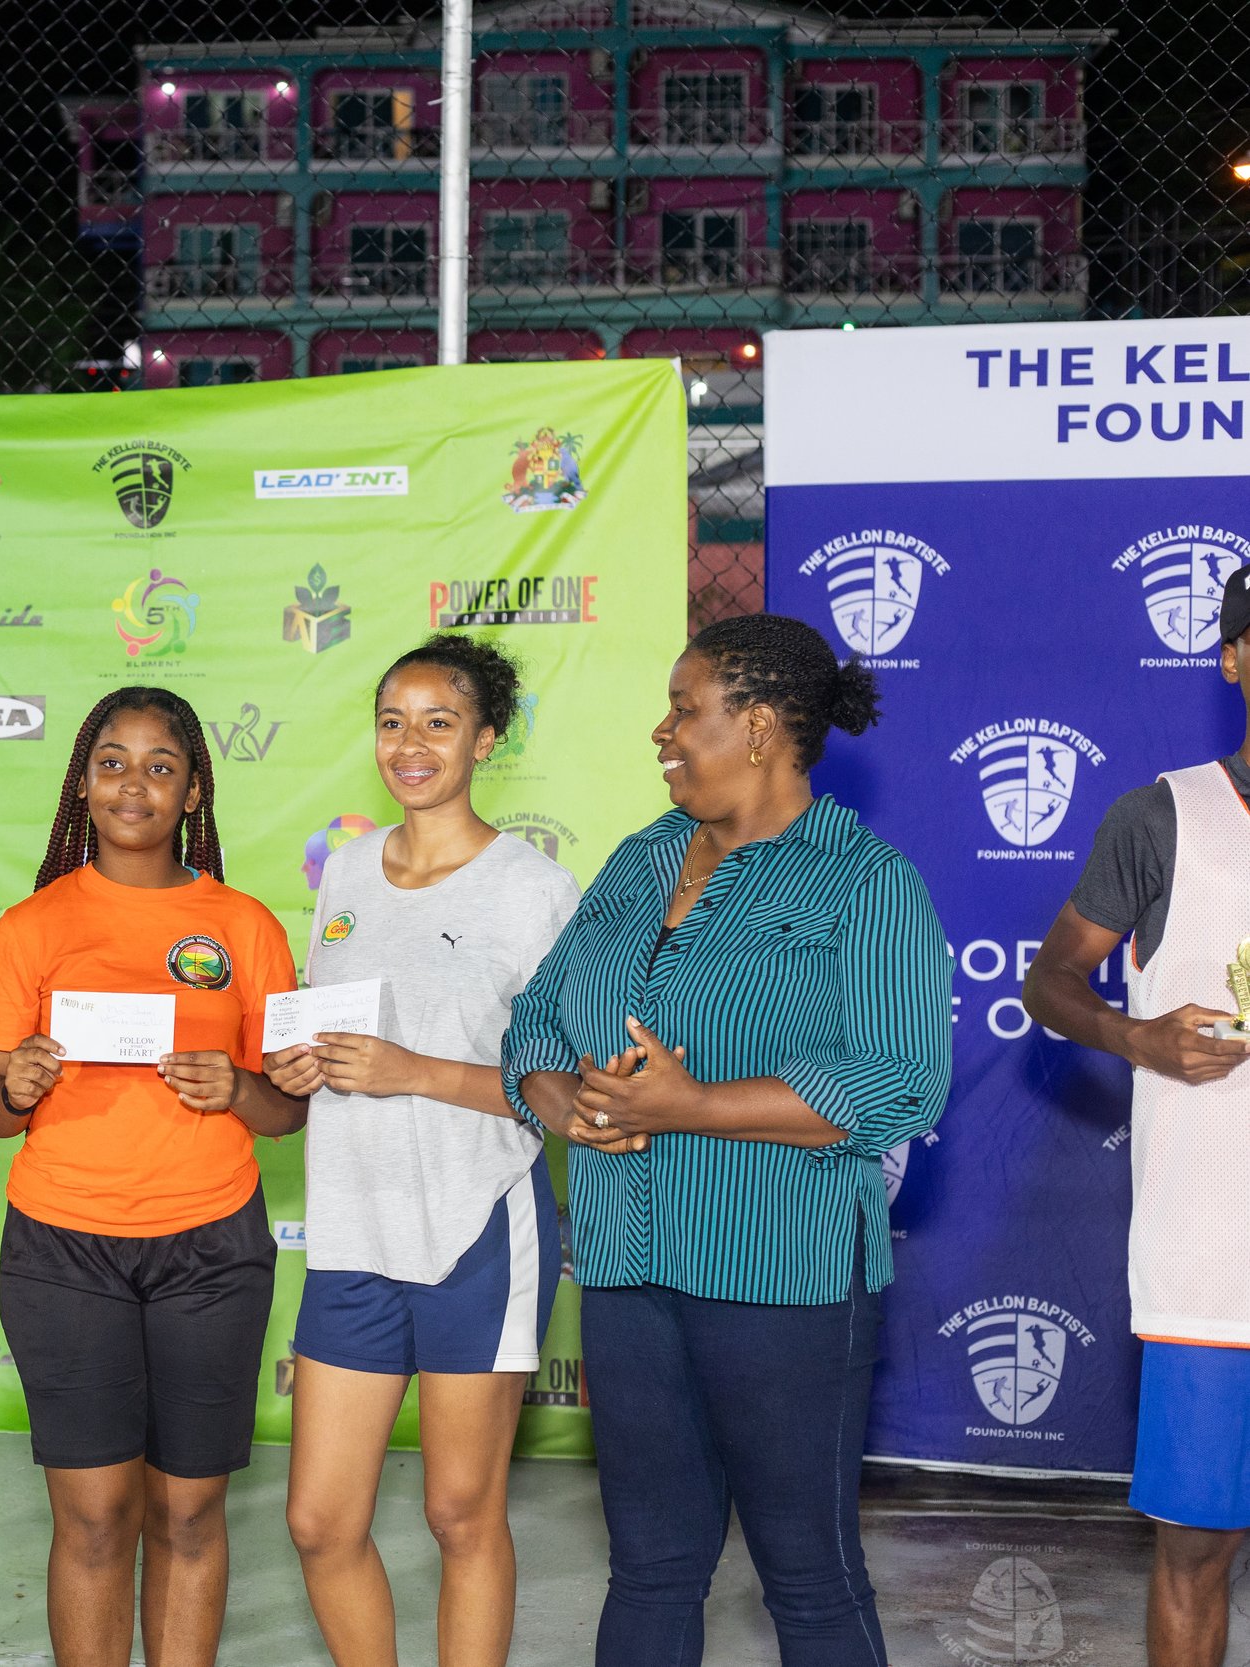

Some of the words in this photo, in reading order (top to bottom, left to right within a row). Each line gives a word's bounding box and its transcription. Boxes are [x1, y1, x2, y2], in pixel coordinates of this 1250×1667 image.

[966, 347, 1094, 388] THE
[1125, 343, 1250, 384] KEL
[1057, 400, 1244, 443] FOUN
[92, 455, 110, 473] THE
[107, 439, 145, 459] KELLON
[147, 440, 192, 472] BAPTISTE
[344, 471, 403, 486] INT.
[798, 548, 827, 576] THE
[822, 529, 882, 557] KELLON
[885, 530, 951, 576] BAPTISTE
[1111, 544, 1141, 572] THE
[1137, 525, 1200, 552] KELLON
[430, 578, 511, 628] POWER
[518, 576, 545, 608] OF
[552, 575, 599, 622] ONE
[452, 611, 569, 625] FOUNDATION
[901, 659, 920, 669] INC
[1140, 657, 1218, 669] FOUNDATION
[949, 737, 979, 765] THE
[974, 718, 1036, 745] KELLON
[1038, 718, 1107, 767] BAPTISTE
[532, 812, 580, 847] BAPTISTE
[977, 849, 1053, 860] FOUNDATION
[1055, 850, 1076, 860] INC
[60, 997, 80, 1009] ENJOY
[81, 1002, 95, 1012] LIFE
[119, 1036, 155, 1045] FOLLOW
[119, 1048, 154, 1057] HEART
[1103, 1124, 1132, 1151] THE
[937, 1311, 967, 1338] THE
[963, 1295, 1025, 1320] KELLON
[1027, 1296, 1096, 1347] BAPTISTE
[966, 1427, 1042, 1440] FOUNDATION
[1045, 1432, 1065, 1441] INC
